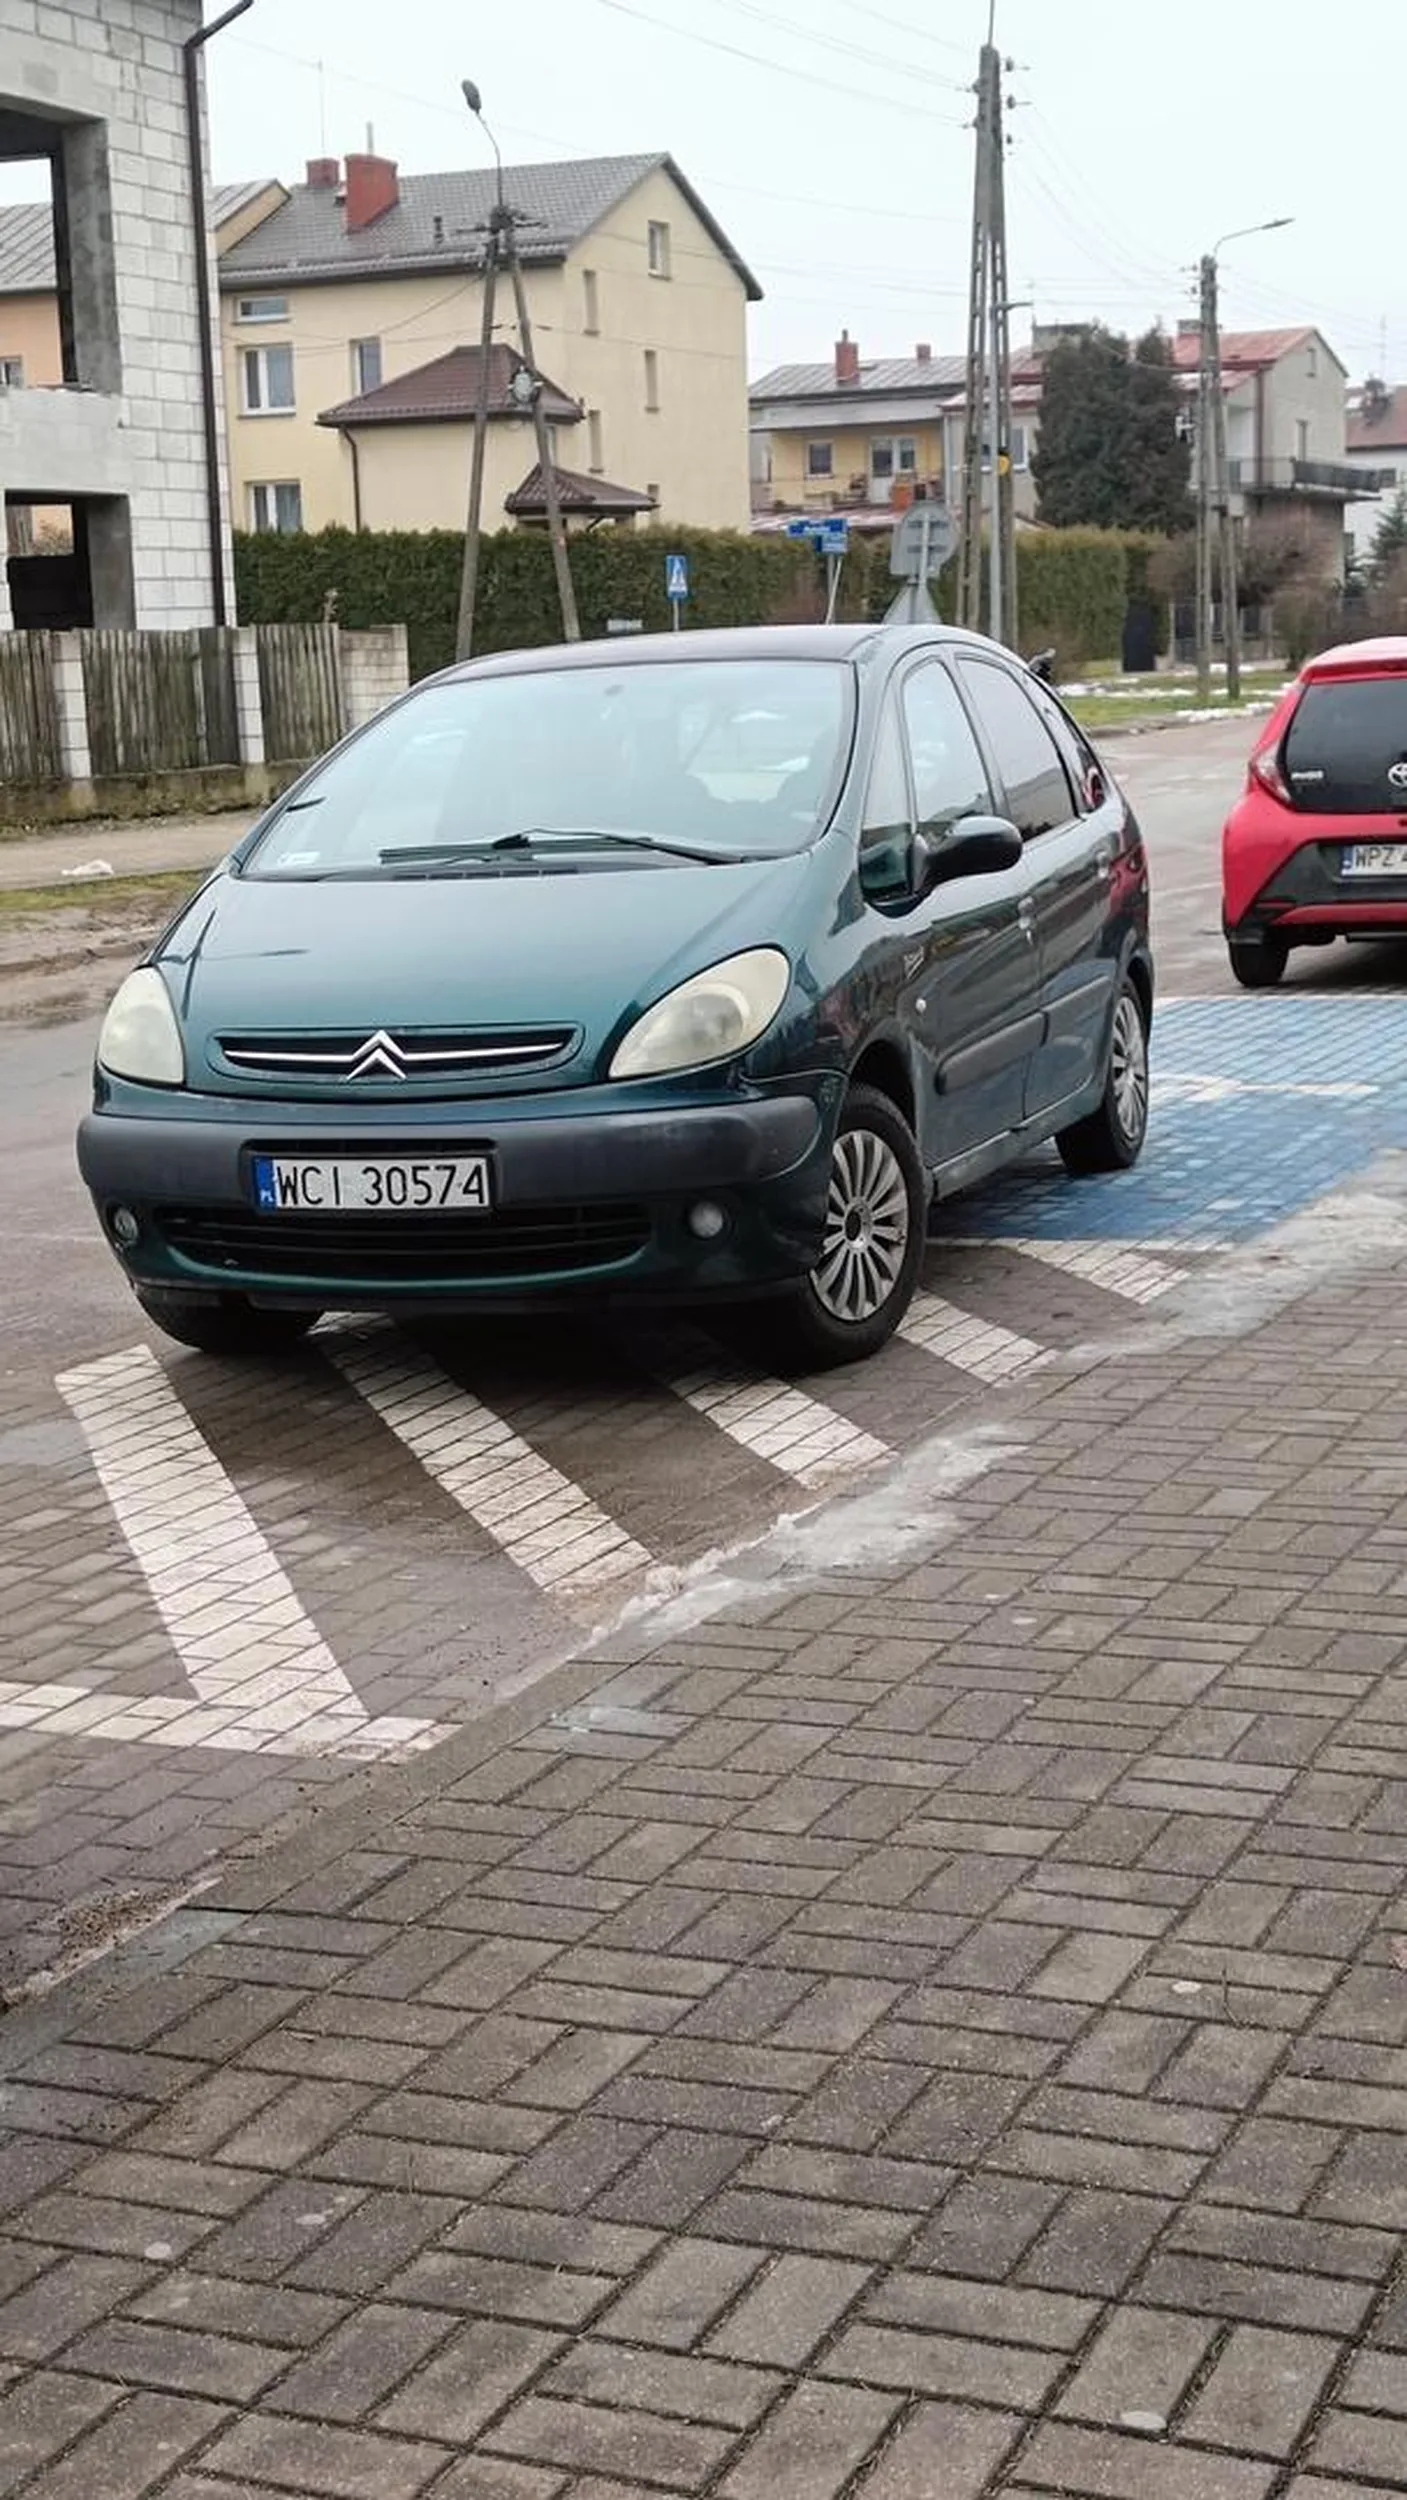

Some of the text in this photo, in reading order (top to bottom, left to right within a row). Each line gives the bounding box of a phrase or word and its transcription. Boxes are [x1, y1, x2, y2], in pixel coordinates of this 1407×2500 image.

[1355, 847, 1395, 867] WPZ
[276, 1164, 486, 1206] WCI 30574
